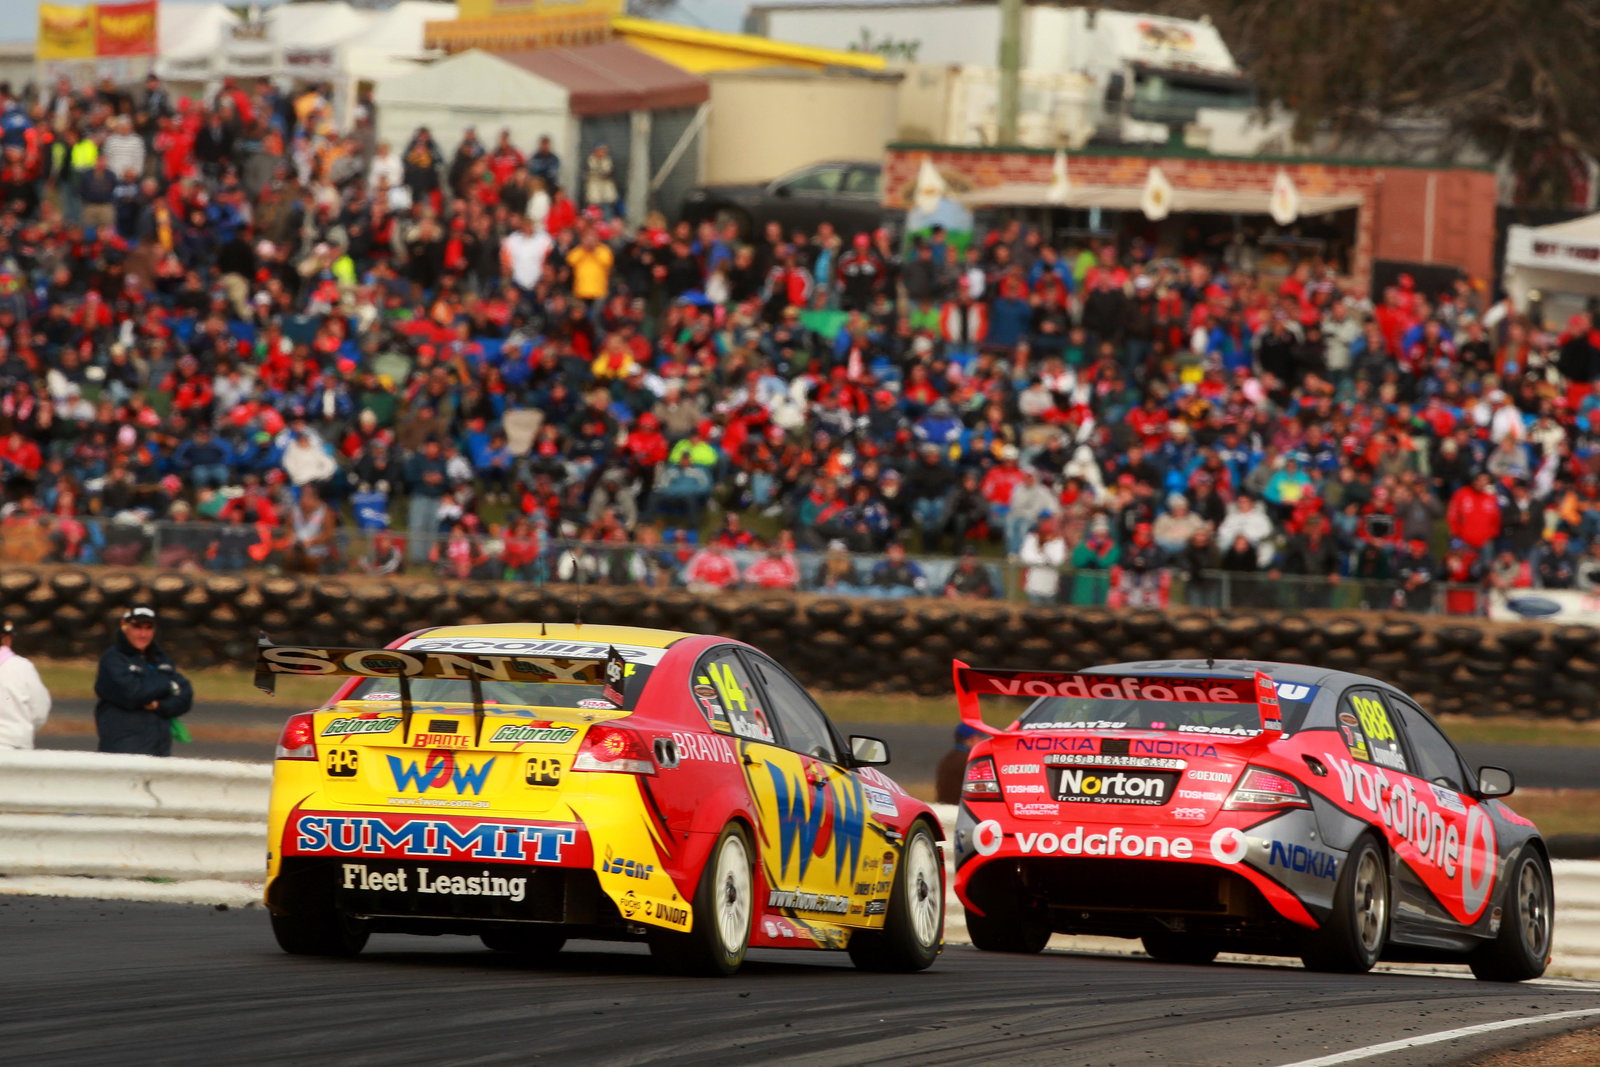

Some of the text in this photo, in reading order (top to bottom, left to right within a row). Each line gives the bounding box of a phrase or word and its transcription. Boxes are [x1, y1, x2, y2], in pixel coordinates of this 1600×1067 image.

[262, 648, 602, 684] SONY
[708, 662, 748, 712] 14
[988, 675, 1239, 702] vodafone
[324, 717, 400, 735] Gatorade
[1023, 720, 1127, 730] KOMATSU
[1352, 695, 1395, 741] 888
[412, 733, 471, 748] BIANTE
[494, 726, 575, 743] Gatorade
[672, 732, 737, 765] BRAVIA
[1016, 737, 1219, 759] NOKIA NOKIA
[328, 749, 358, 774] PPG
[386, 749, 498, 796] WOW
[527, 758, 561, 783] PPG
[1008, 764, 1040, 774] DEXION
[1005, 784, 1045, 794] TOSHIBA
[1059, 769, 1165, 797] Norton
[1197, 772, 1232, 783] DEXION
[1094, 796, 1161, 806] symantec
[1178, 789, 1224, 801] TOSHIBA
[1324, 753, 1459, 879] vodafone
[297, 815, 576, 863] SUMMIT
[1014, 826, 1194, 858] vodafone
[1268, 840, 1337, 882] NOKIA
[342, 863, 527, 902] Fleet Leasing
